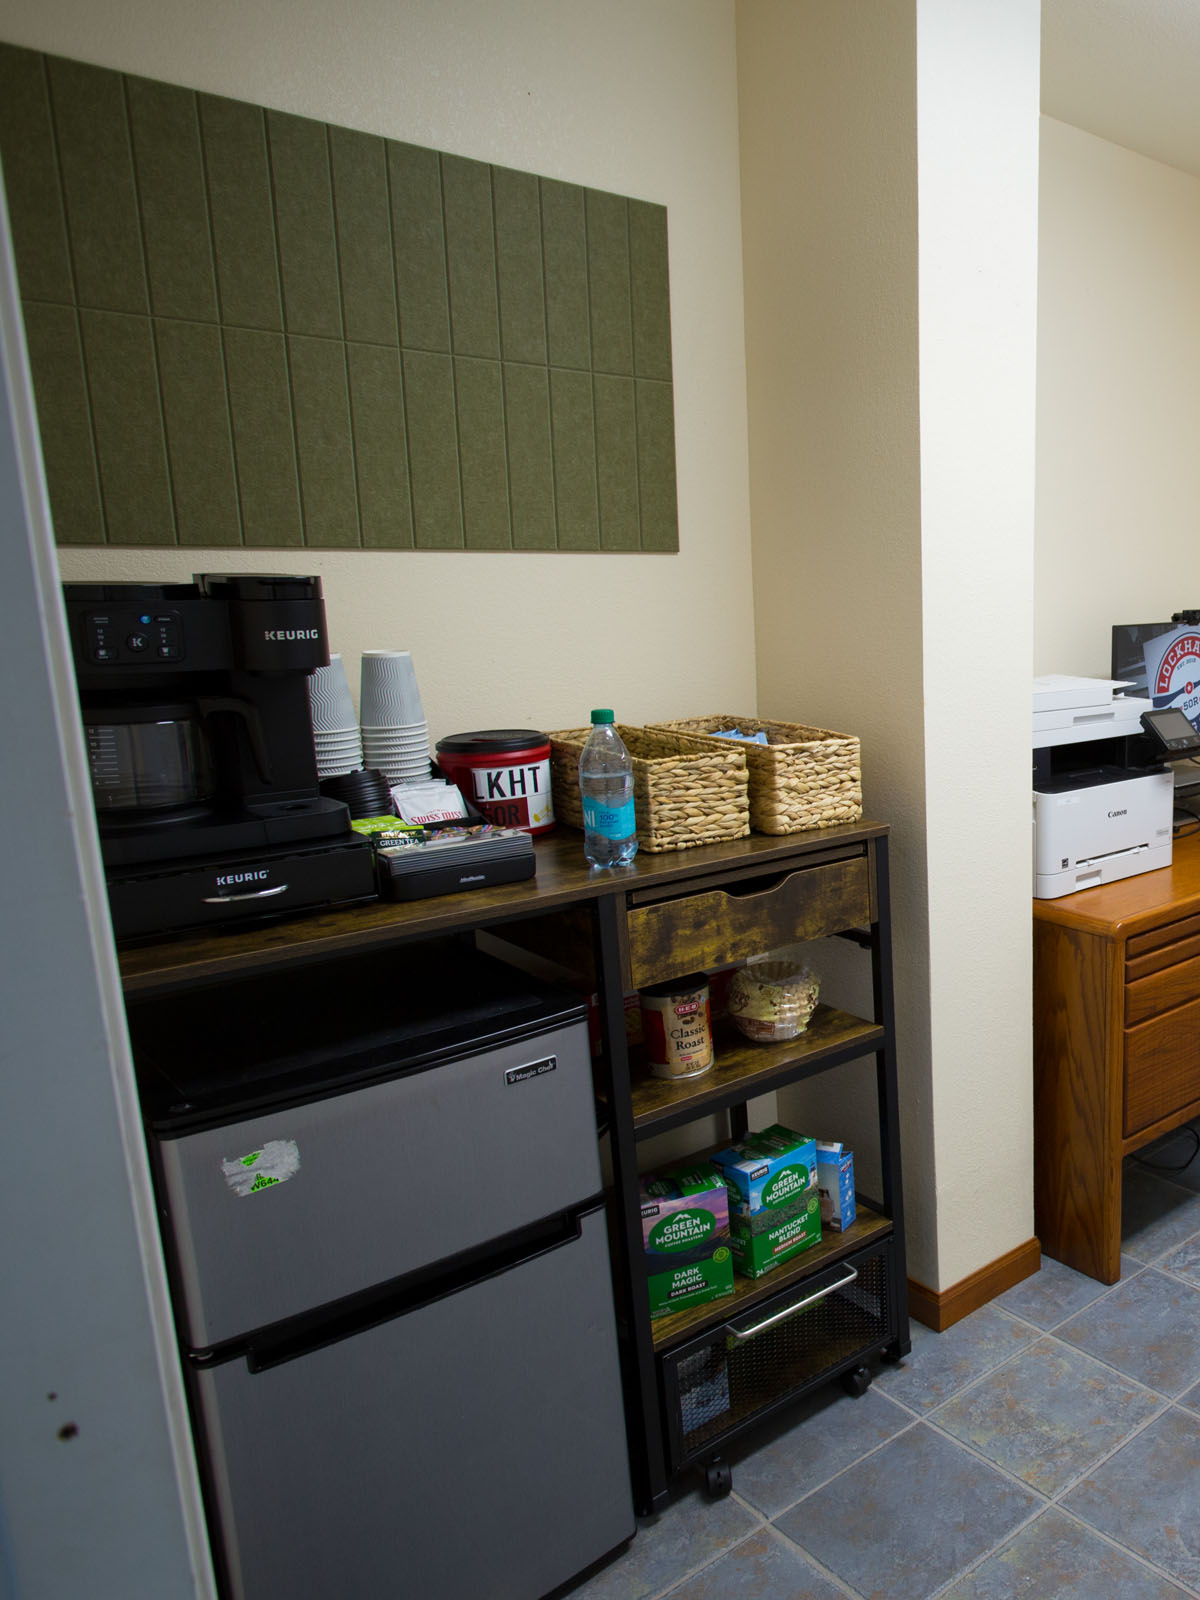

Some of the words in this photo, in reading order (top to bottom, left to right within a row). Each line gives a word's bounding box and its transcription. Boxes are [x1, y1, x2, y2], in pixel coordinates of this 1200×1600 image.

[264, 629, 319, 641] KEURIG
[410, 813, 441, 825] SWISS
[1107, 809, 1128, 818] Canon
[380, 839, 405, 847] GREEN
[216, 870, 269, 886] KEURIG
[671, 1024, 705, 1040] Classic
[676, 1036, 704, 1050] Roast
[772, 1171, 799, 1192] GREEN
[765, 1176, 806, 1204] MOUNTAIN
[663, 1216, 701, 1235] GREEN
[768, 1212, 809, 1241] NANTUCKET
[655, 1222, 711, 1246] MOUNTAIN
[778, 1226, 802, 1244] BLEND
[671, 1273, 703, 1290] MAGIC
[673, 1266, 700, 1281] DARK
